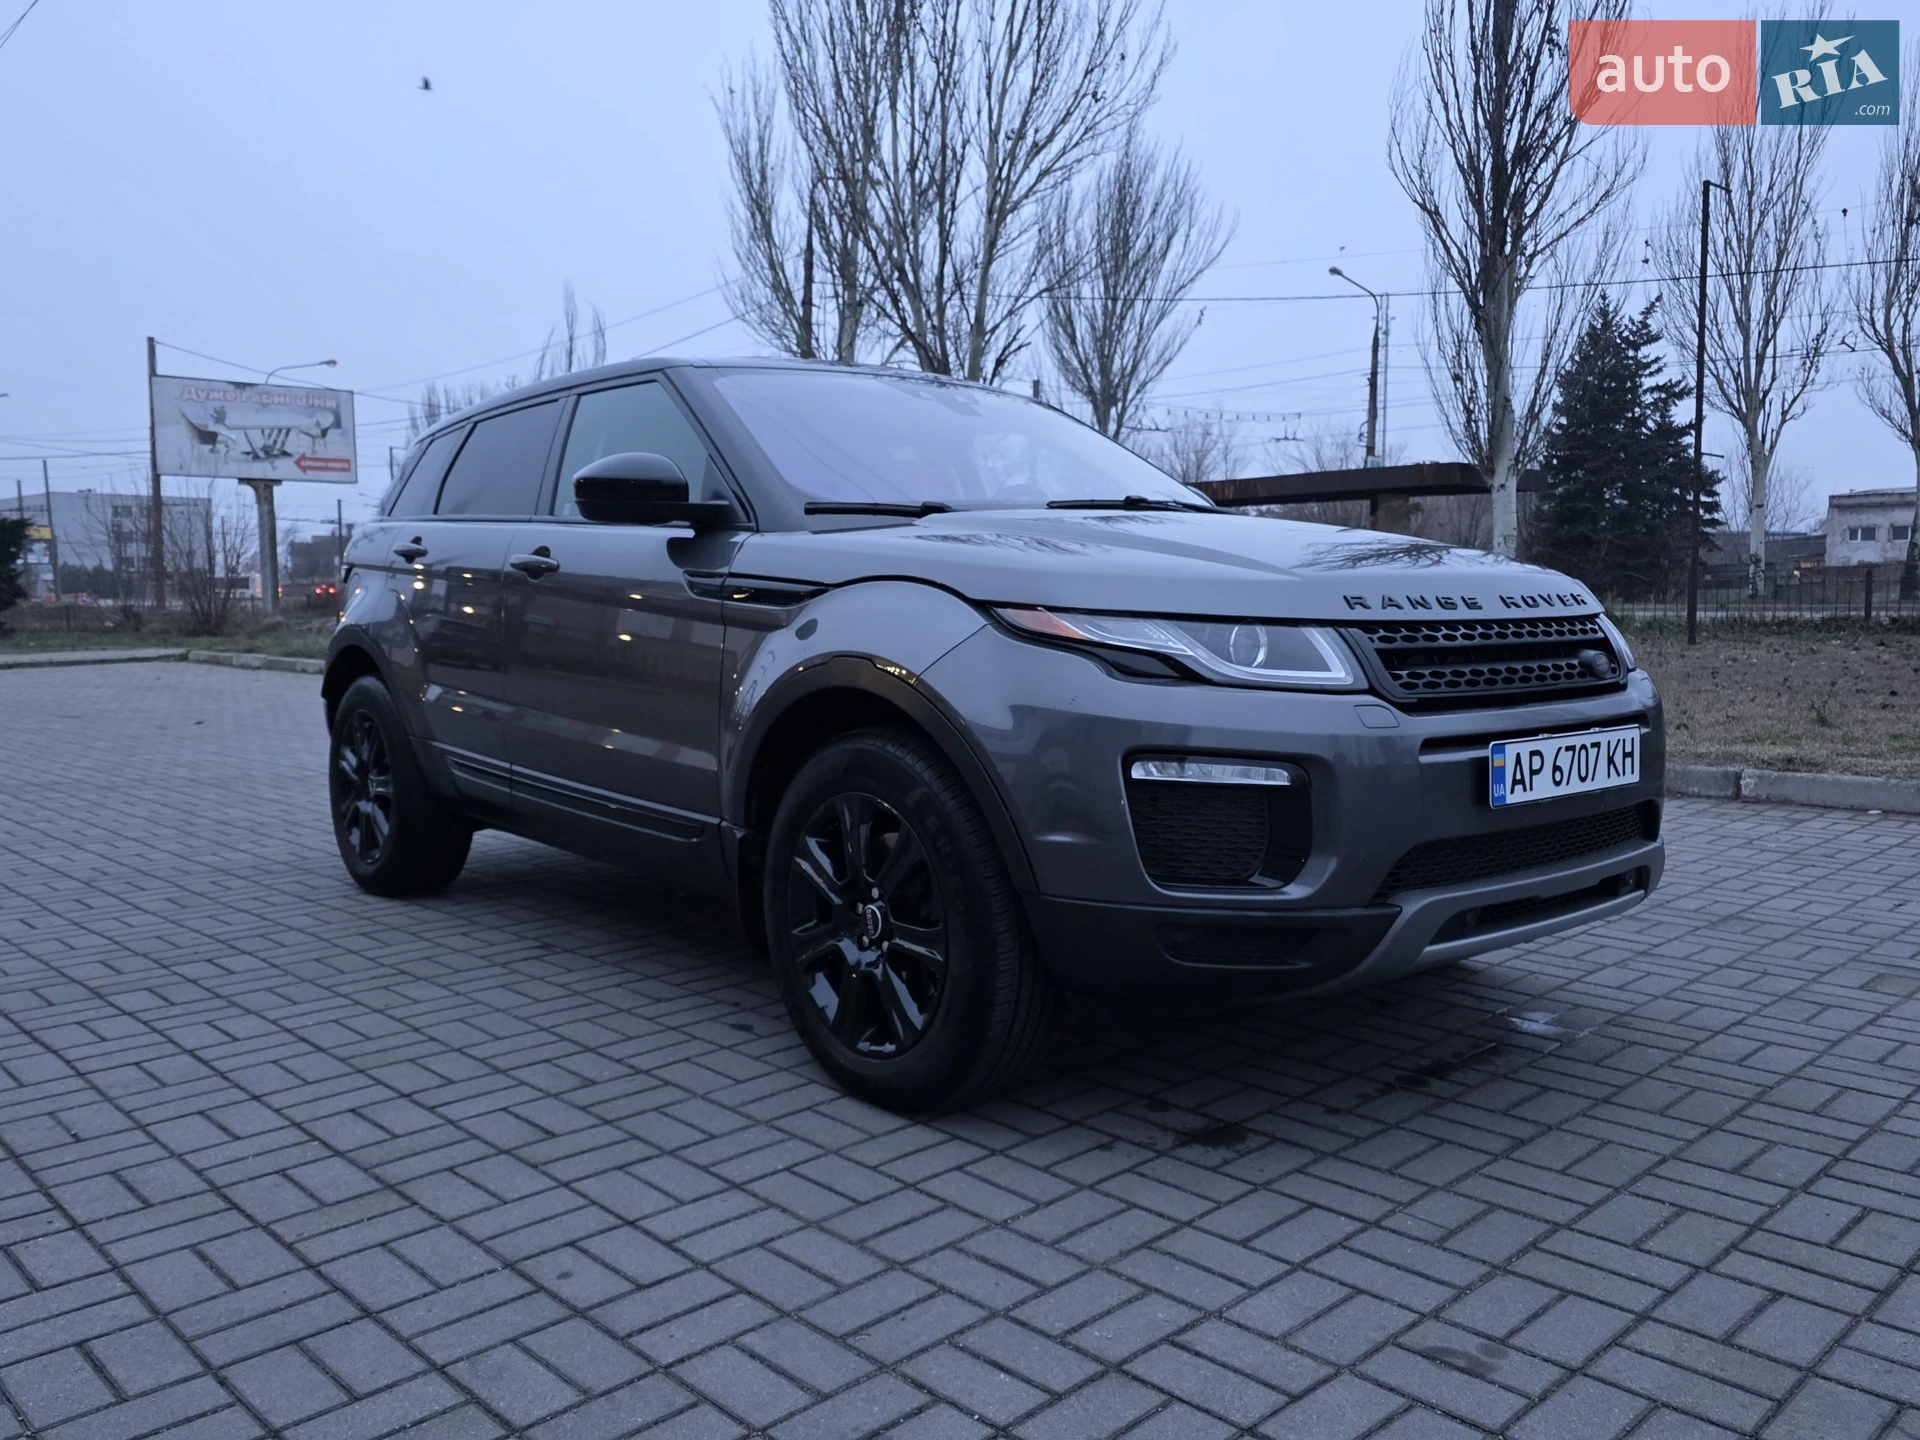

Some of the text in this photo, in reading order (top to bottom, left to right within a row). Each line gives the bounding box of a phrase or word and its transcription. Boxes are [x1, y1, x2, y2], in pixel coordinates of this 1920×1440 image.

[181, 386, 237, 404] Дуже
[1343, 592, 1588, 611] RANGE ROVER
[1510, 737, 1634, 794] AP 6707 KH
[1493, 784, 1506, 797] UA
